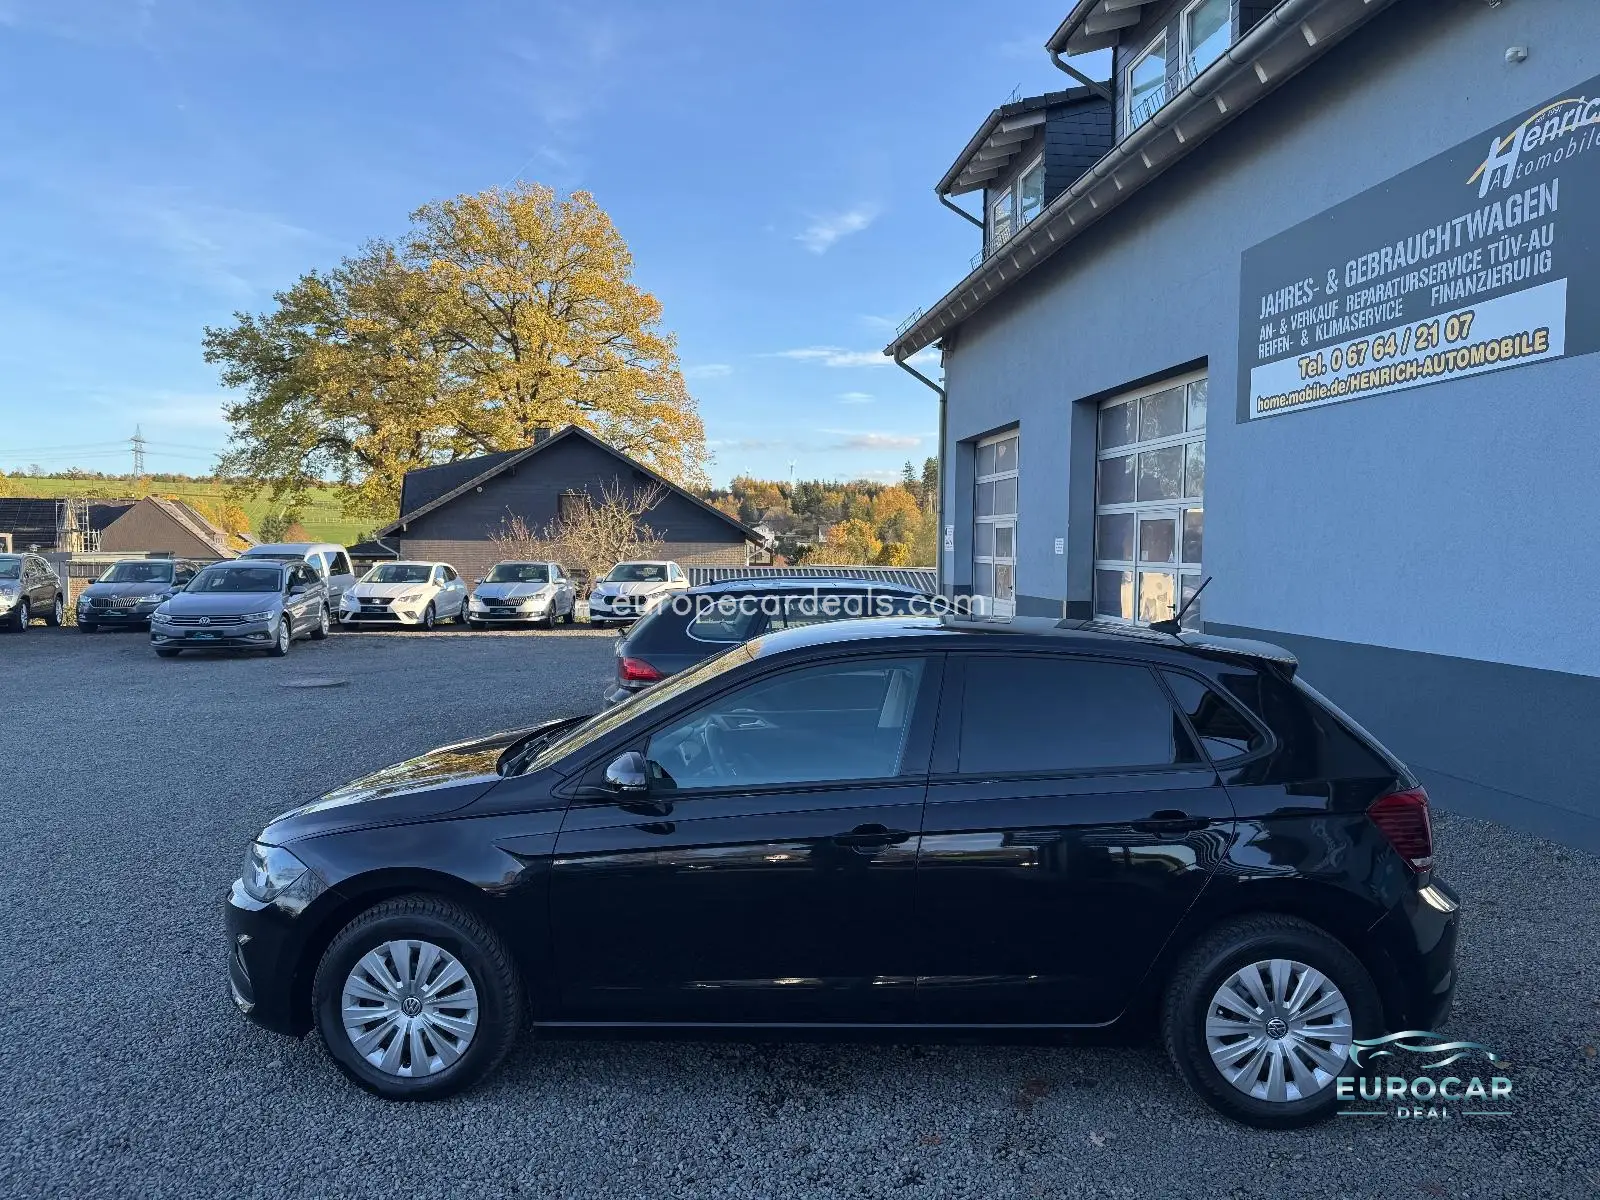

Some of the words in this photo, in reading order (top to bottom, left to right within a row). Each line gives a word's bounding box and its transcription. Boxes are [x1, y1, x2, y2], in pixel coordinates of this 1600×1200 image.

[1479, 95, 1600, 198] Henric
[1490, 127, 1600, 191] Atomobile
[1259, 276, 1320, 320] JAHRES-
[1325, 267, 1339, 295] &
[1344, 177, 1559, 289] GEBRAUCHTWAGEN
[1279, 316, 1288, 335] &
[1290, 299, 1339, 331] VERKAUF
[1346, 248, 1482, 311] REPARATURSERVICE
[1488, 223, 1554, 264] TÜV-AU
[1256, 327, 1550, 414] home.mobile.de/HENRICH-AUTOMOBILE
[1258, 332, 1294, 360] REIFEN-
[1300, 327, 1309, 347] &
[1315, 298, 1403, 342] KLIMASERVICE
[1299, 352, 1327, 380] Tel.
[1330, 348, 1343, 372] 0
[1345, 342, 1369, 370] 67
[1372, 332, 1398, 361] 64
[1401, 329, 1411, 356] /
[1414, 323, 1440, 351] 21
[1445, 310, 1475, 343] 07
